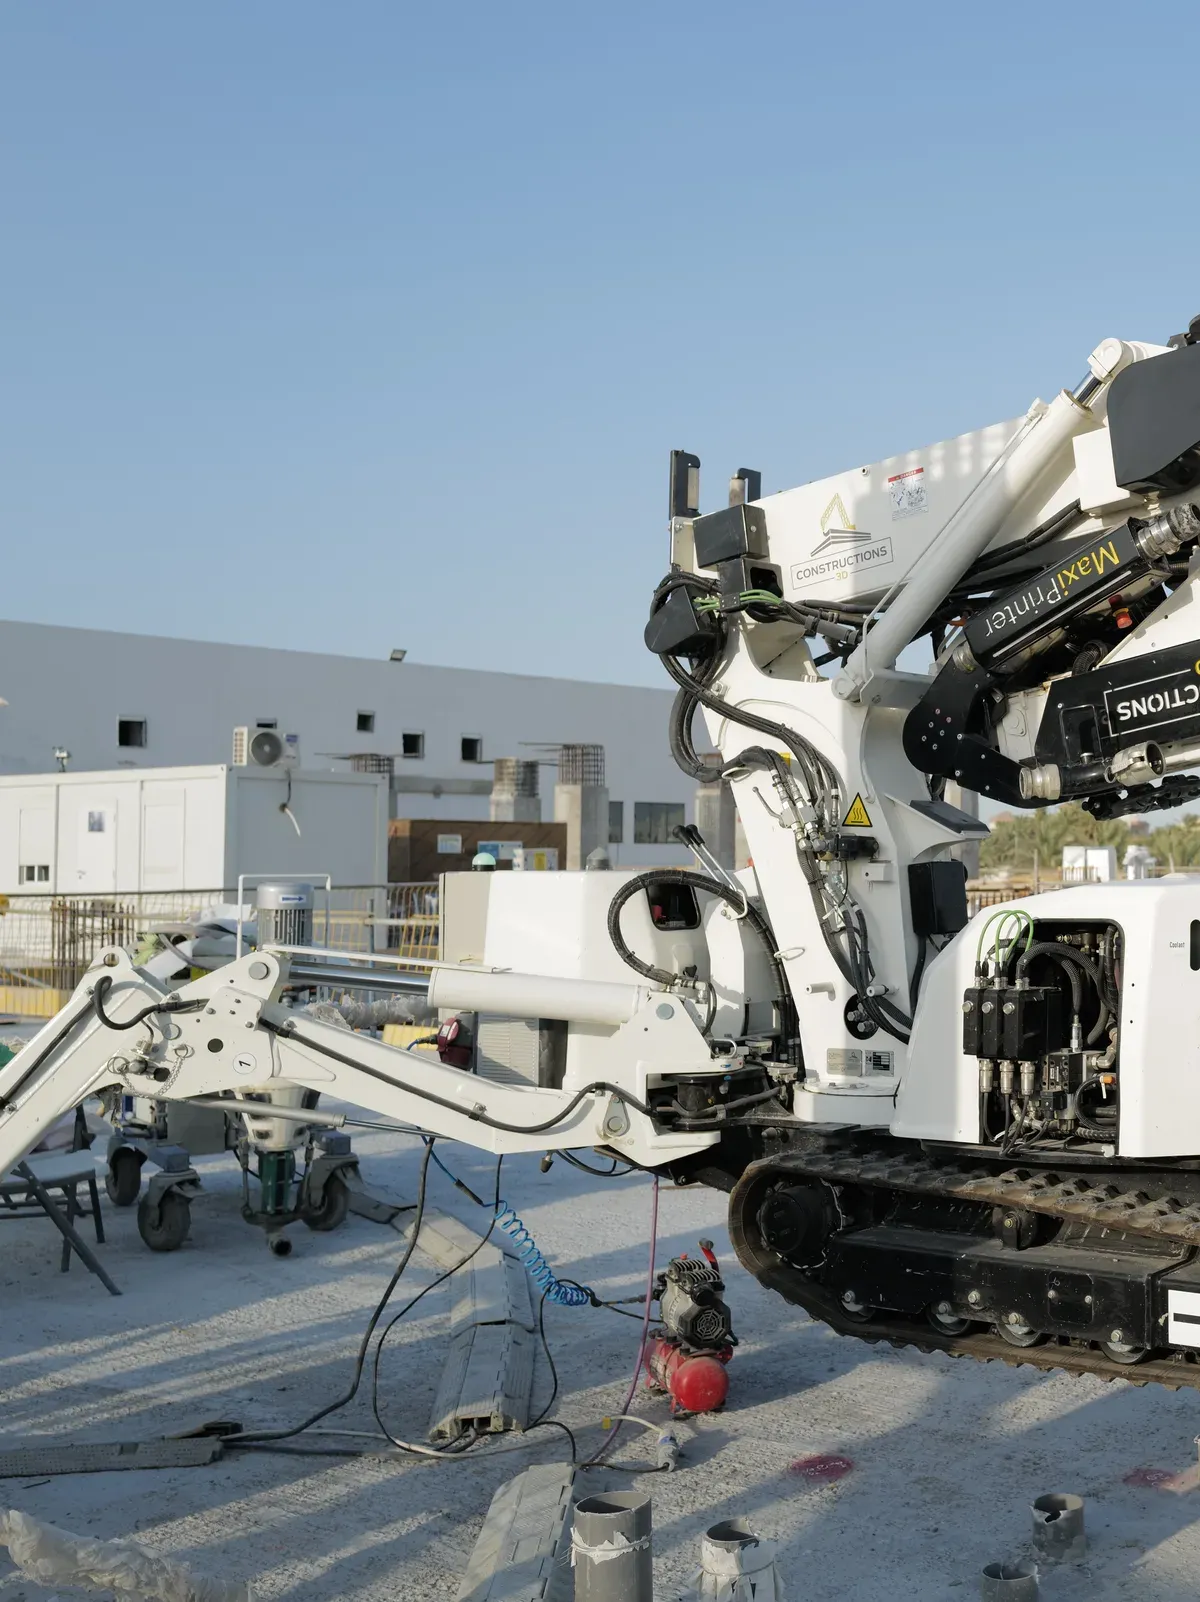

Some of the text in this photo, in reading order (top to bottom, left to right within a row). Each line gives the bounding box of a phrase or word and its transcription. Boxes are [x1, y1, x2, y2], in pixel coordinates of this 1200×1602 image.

[796, 546, 888, 581] CONSTRUCTIONS
[835, 571, 849, 581] 3D
[986, 541, 1120, 637] MaxiPrinter
[1169, 941, 1185, 949] Coolant
